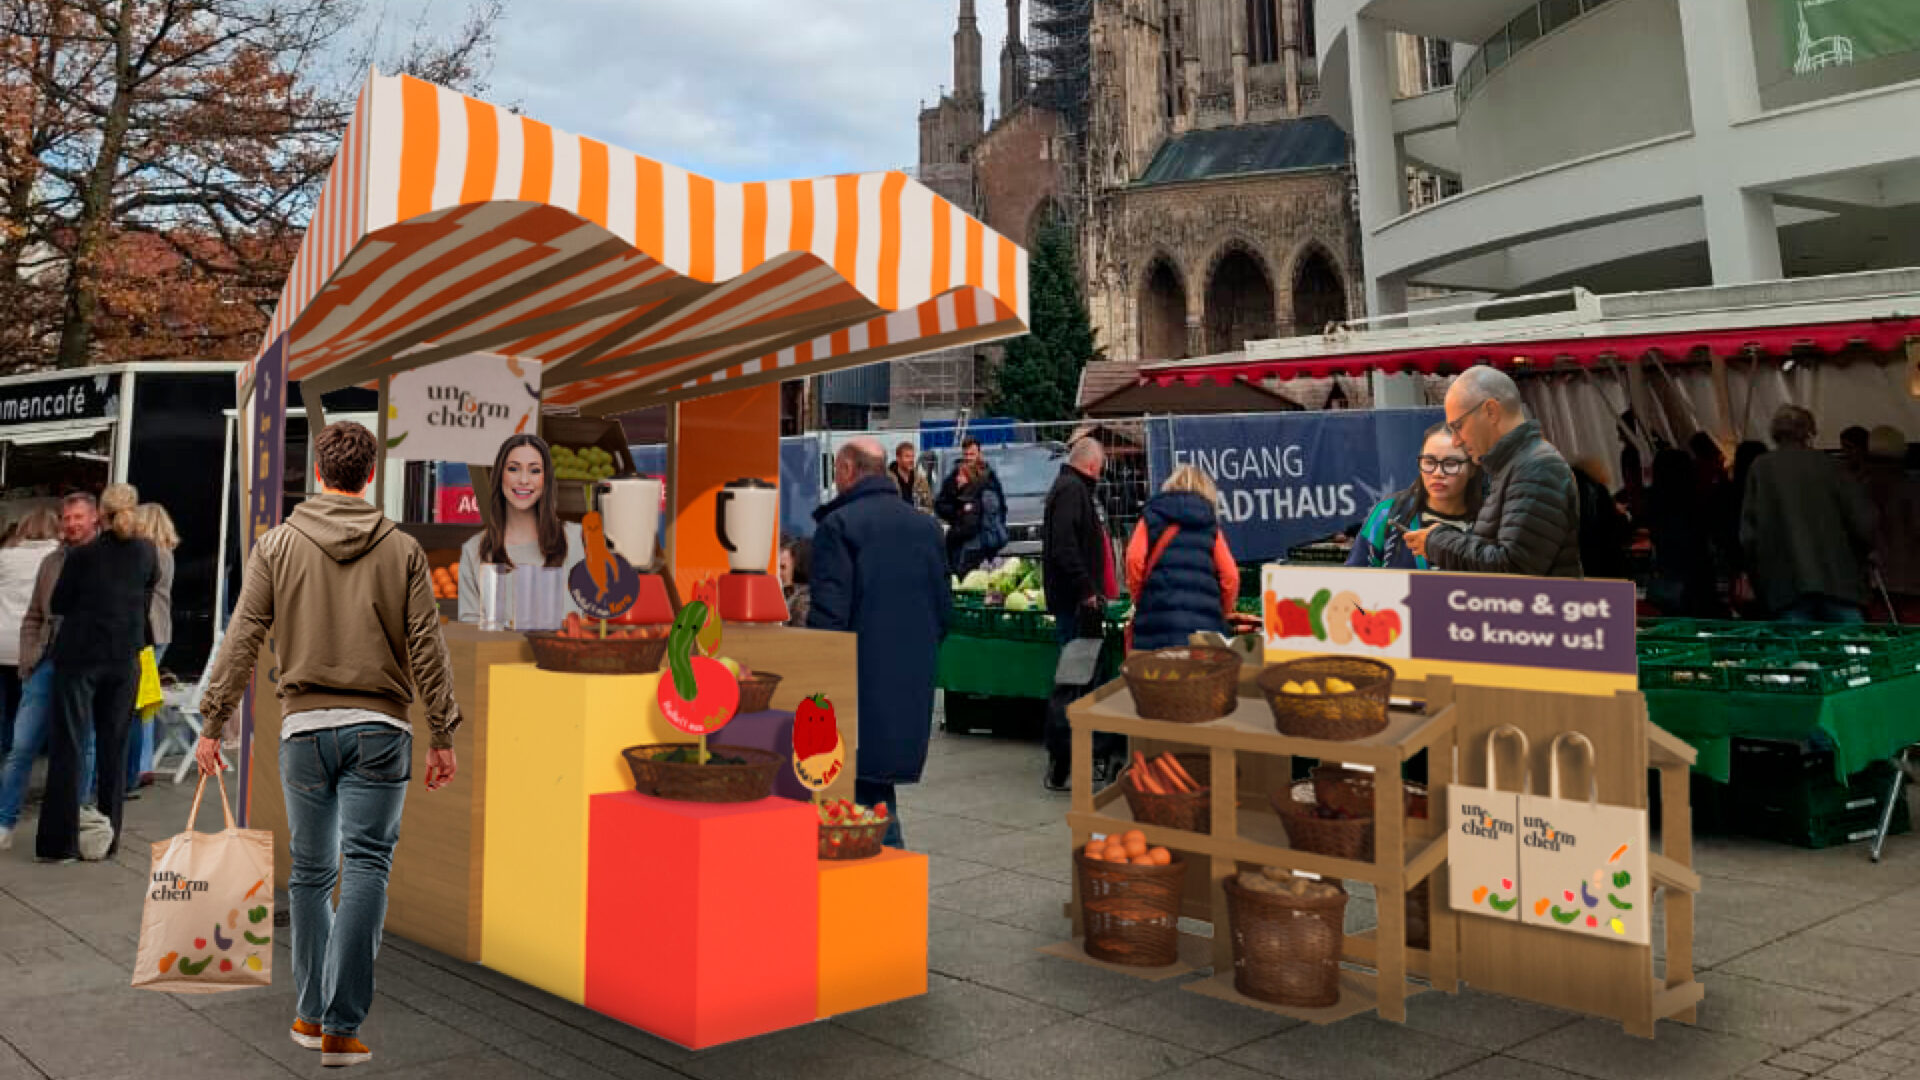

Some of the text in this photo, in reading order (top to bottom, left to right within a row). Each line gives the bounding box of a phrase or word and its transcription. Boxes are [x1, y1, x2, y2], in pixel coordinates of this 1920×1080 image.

[0, 385, 85, 420] mencafé
[427, 404, 485, 429] chen
[1215, 484, 1357, 522] ADTHAUS
[1447, 589, 1612, 623] Come & get
[1448, 620, 1605, 652] to know us!
[1461, 818, 1499, 840] chen
[1523, 830, 1561, 852] chen
[151, 884, 192, 902] chen
